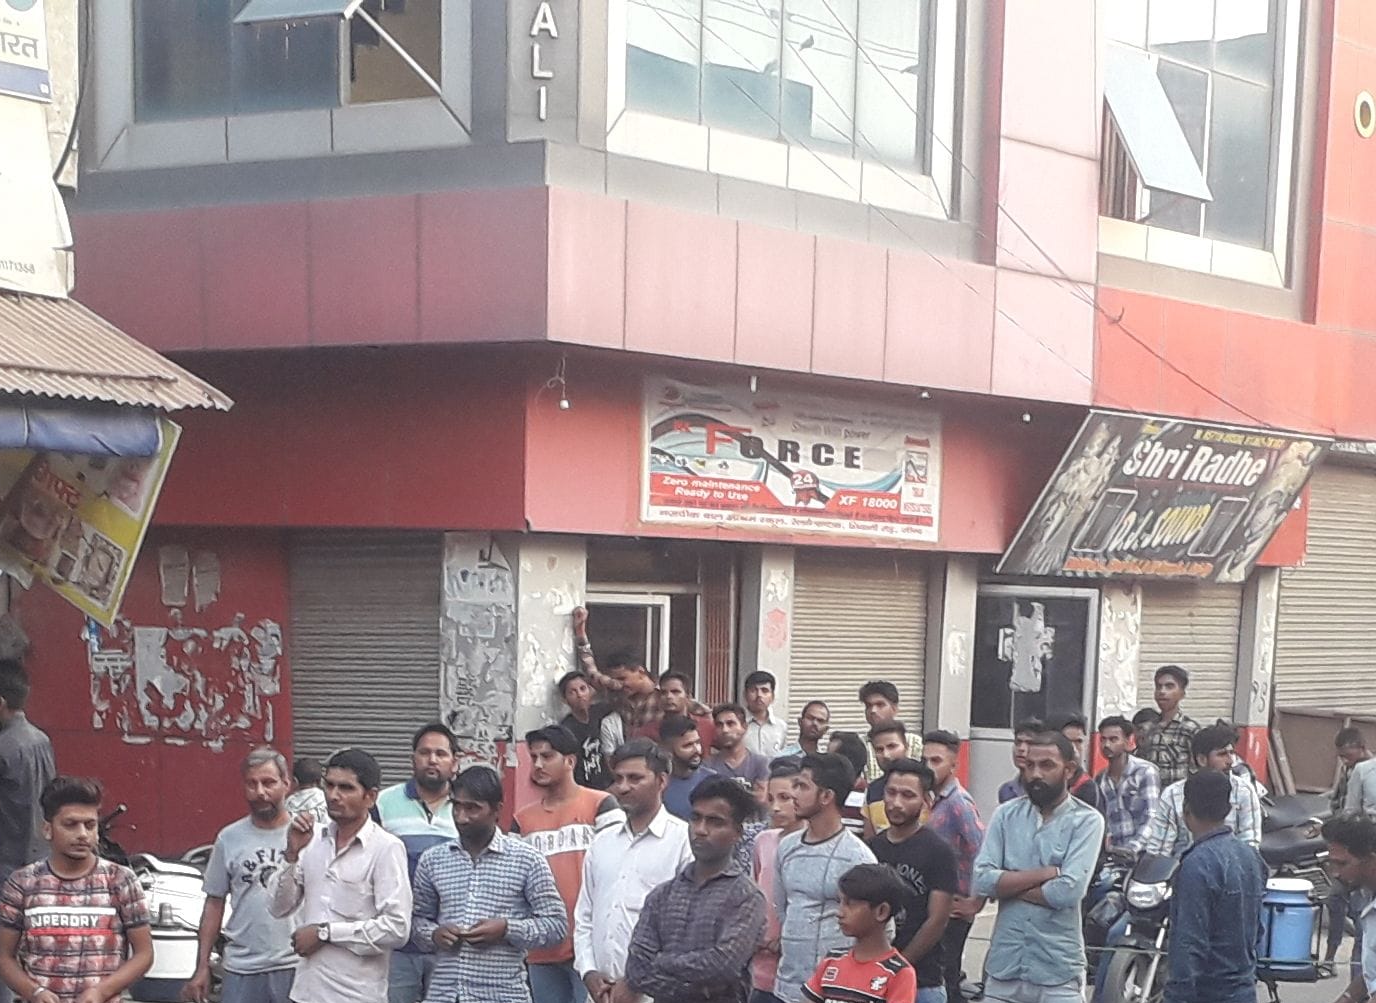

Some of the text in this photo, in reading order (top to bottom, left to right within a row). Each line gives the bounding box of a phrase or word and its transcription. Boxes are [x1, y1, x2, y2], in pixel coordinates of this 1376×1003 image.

[1123, 439, 1193, 480] Shri
[1182, 445, 1267, 487] Radhe
[792, 473, 814, 486] 24
[713, 488, 725, 499] to
[727, 490, 749, 502] Use
[838, 495, 859, 506] XF
[862, 497, 898, 509] 18000
